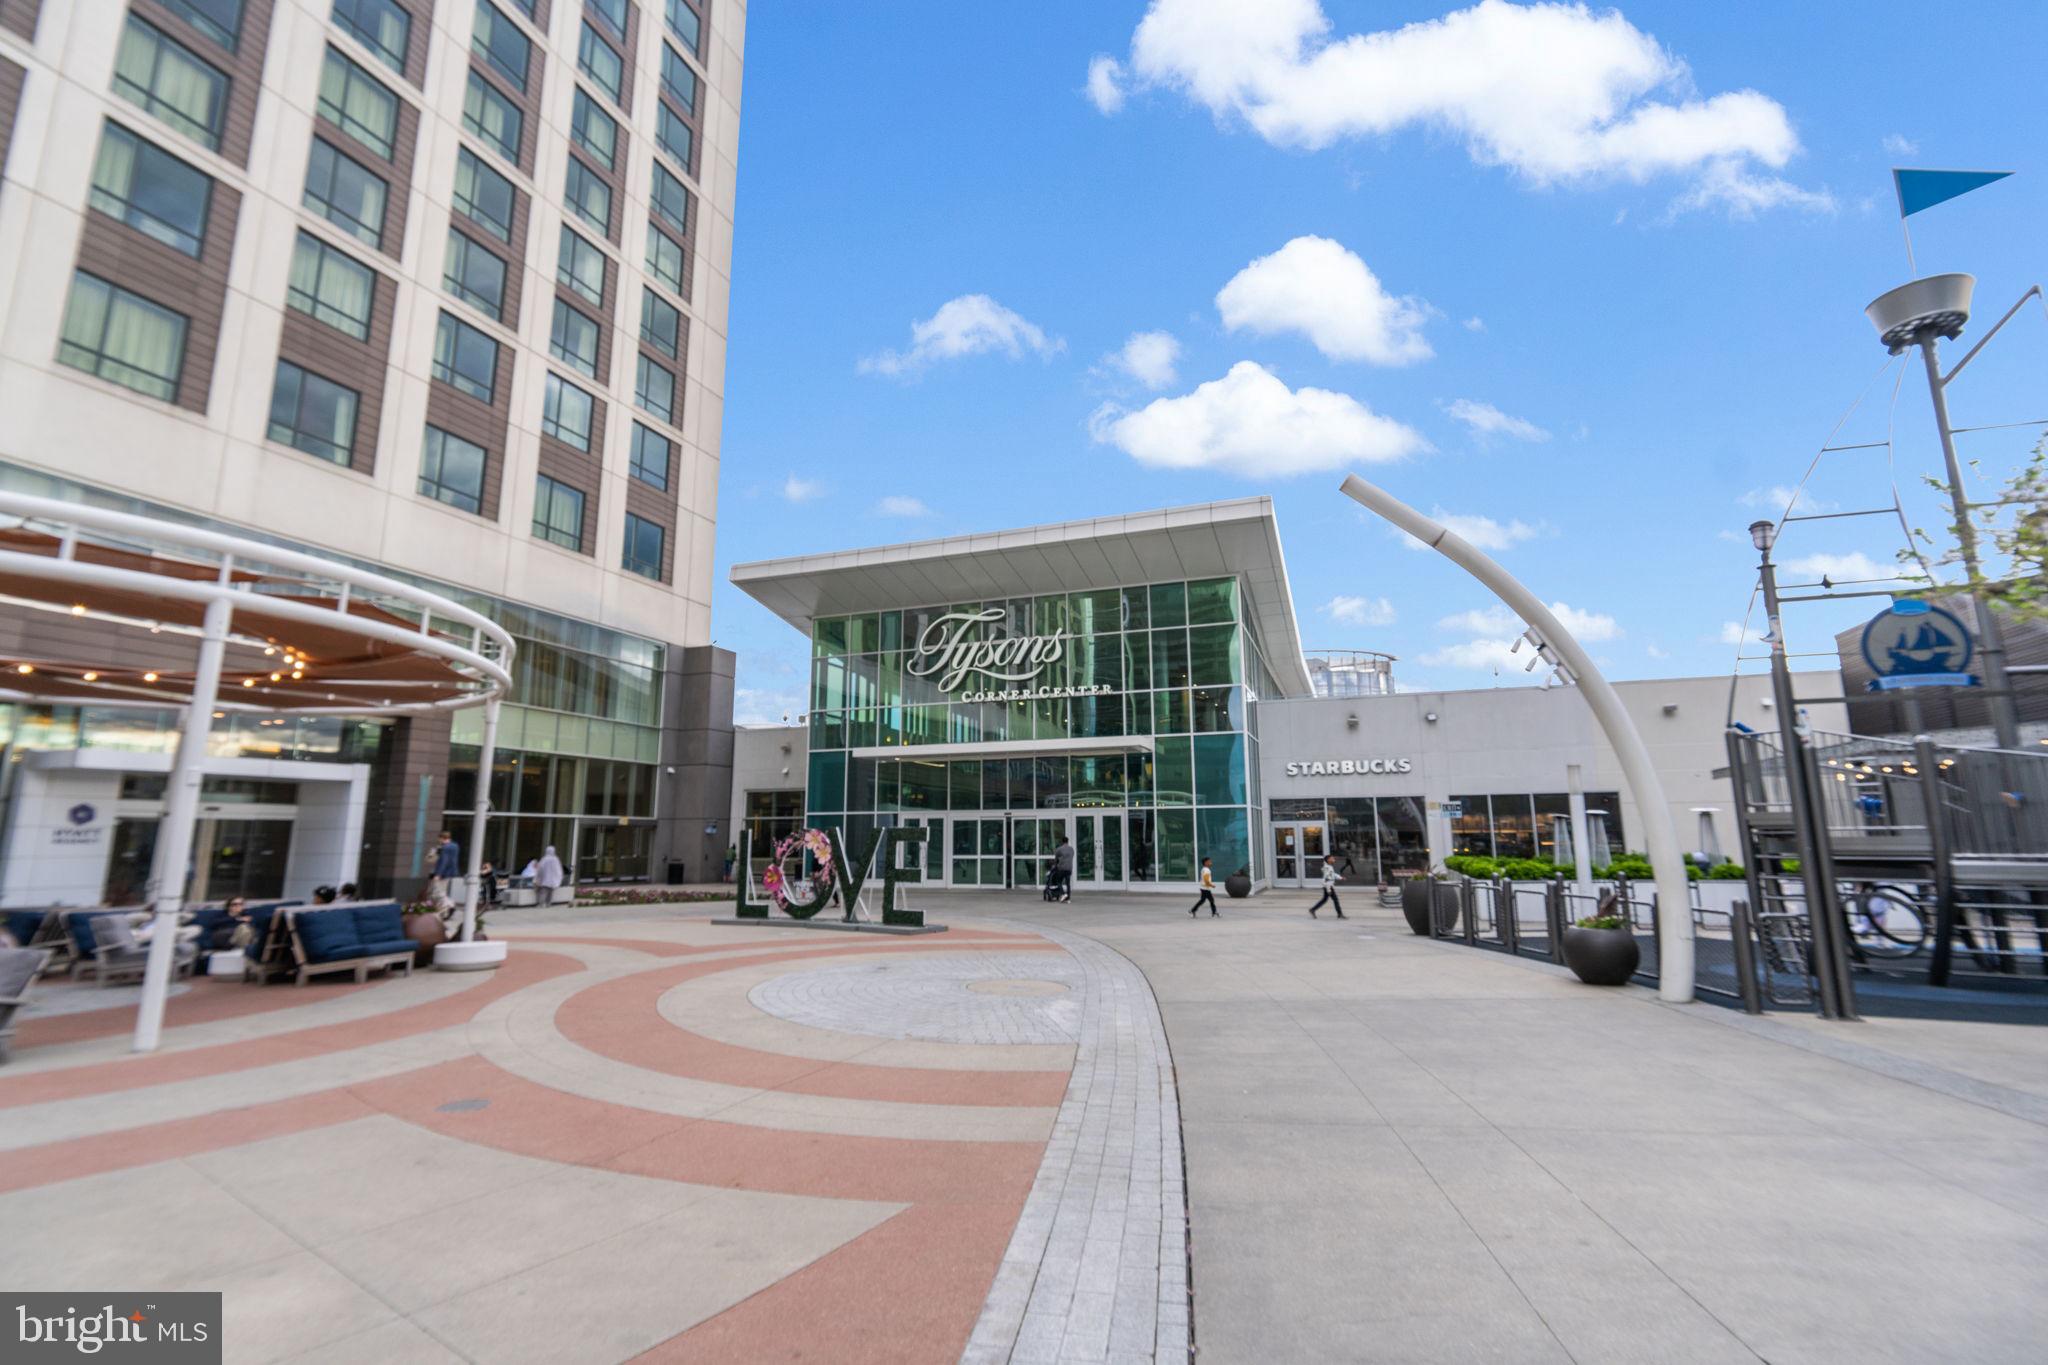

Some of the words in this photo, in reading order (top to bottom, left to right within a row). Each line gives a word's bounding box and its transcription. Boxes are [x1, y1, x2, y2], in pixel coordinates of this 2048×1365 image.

[907, 608, 1064, 693] Tysons
[961, 689, 1032, 703] CORNER
[1038, 684, 1114, 698] CENTER
[1286, 758, 1412, 777] STARBUCKS
[736, 826, 930, 926] LOVE
